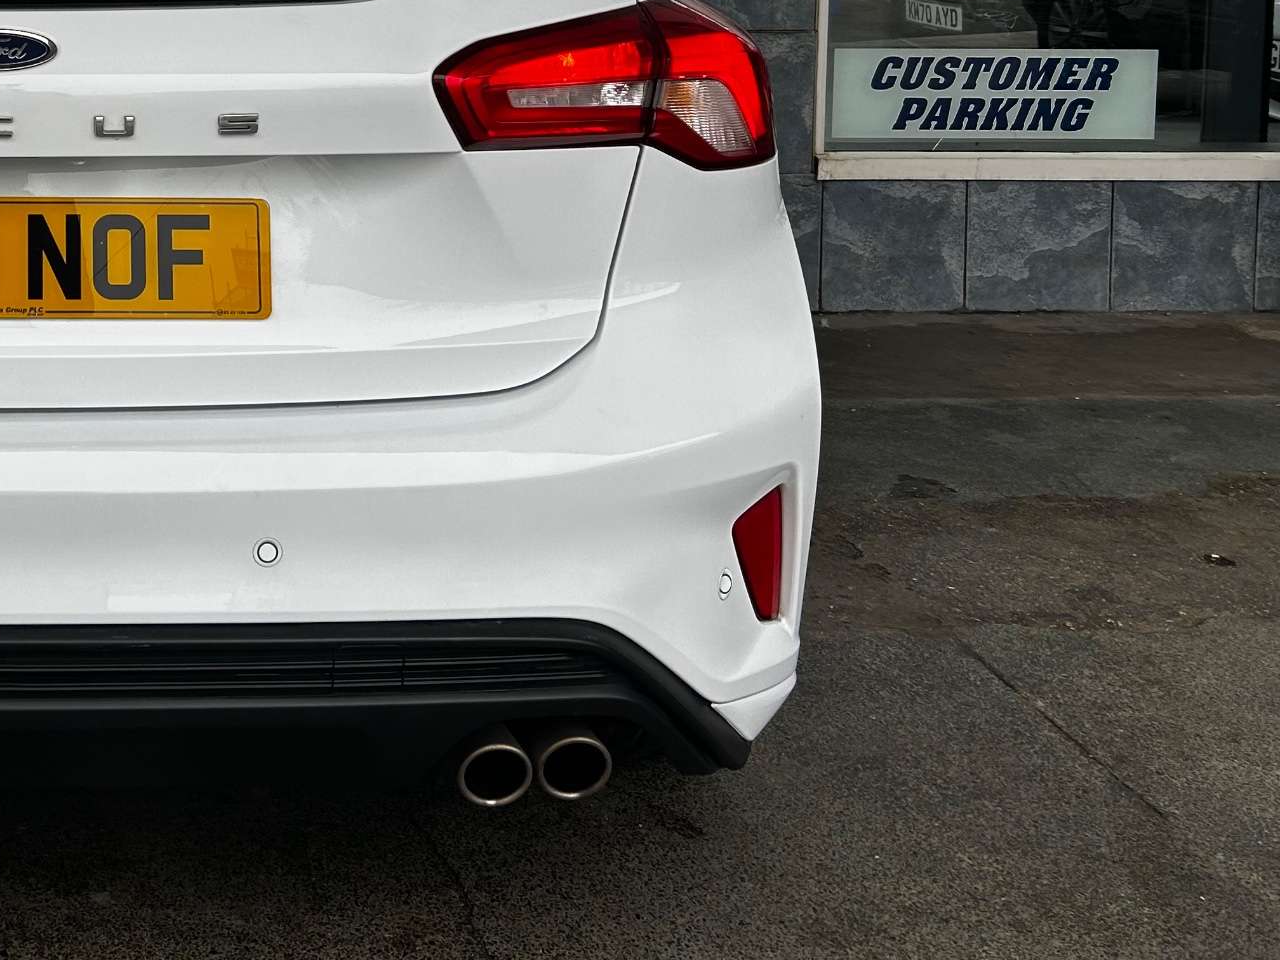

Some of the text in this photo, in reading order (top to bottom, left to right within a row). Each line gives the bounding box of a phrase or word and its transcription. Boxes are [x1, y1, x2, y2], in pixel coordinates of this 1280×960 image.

[935, 6, 958, 28] AYD
[871, 56, 1120, 91] CUSTOMER
[892, 97, 1095, 132] PARKING
[26, 213, 211, 301] NOF
[5, 306, 28, 315] Group
[28, 306, 44, 314] PLC
